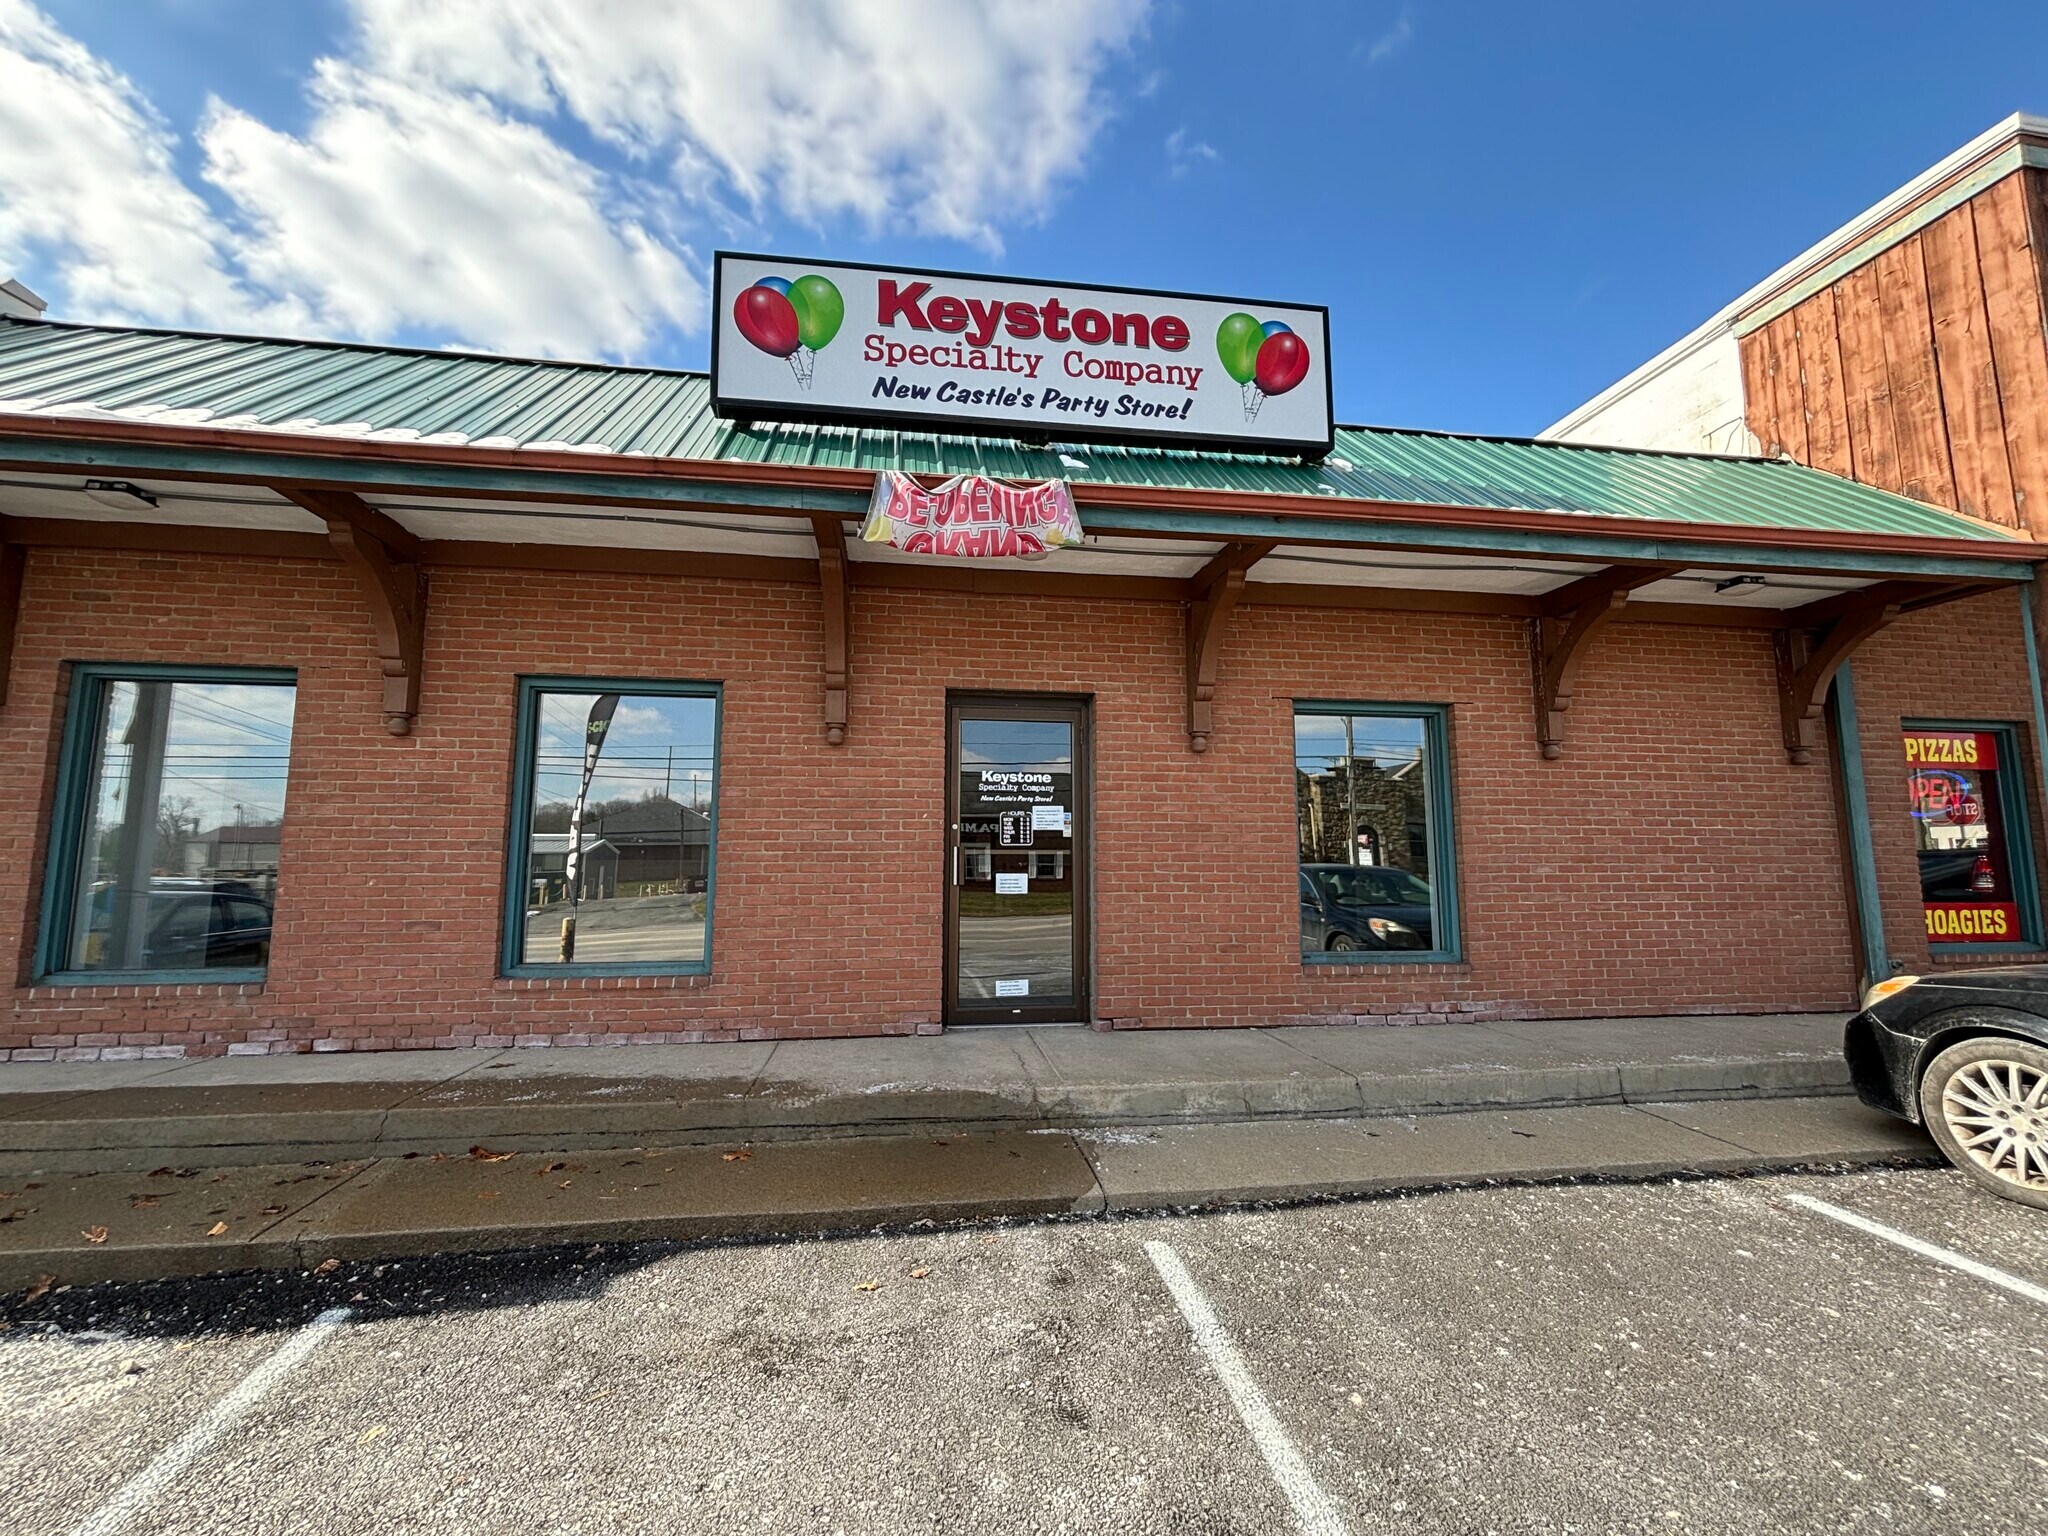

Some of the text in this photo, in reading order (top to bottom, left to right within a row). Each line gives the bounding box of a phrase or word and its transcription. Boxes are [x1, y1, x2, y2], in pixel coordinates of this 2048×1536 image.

[878, 279, 1190, 352] Keystone
[864, 334, 1203, 391] Specialty Company
[872, 376, 1193, 420] New Castle's Party Store!
[1903, 738, 1978, 763] PIZZAS
[978, 783, 1055, 793] Specialty Company
[981, 770, 1052, 785] Keystone
[1925, 909, 2007, 934] HOAGIES
